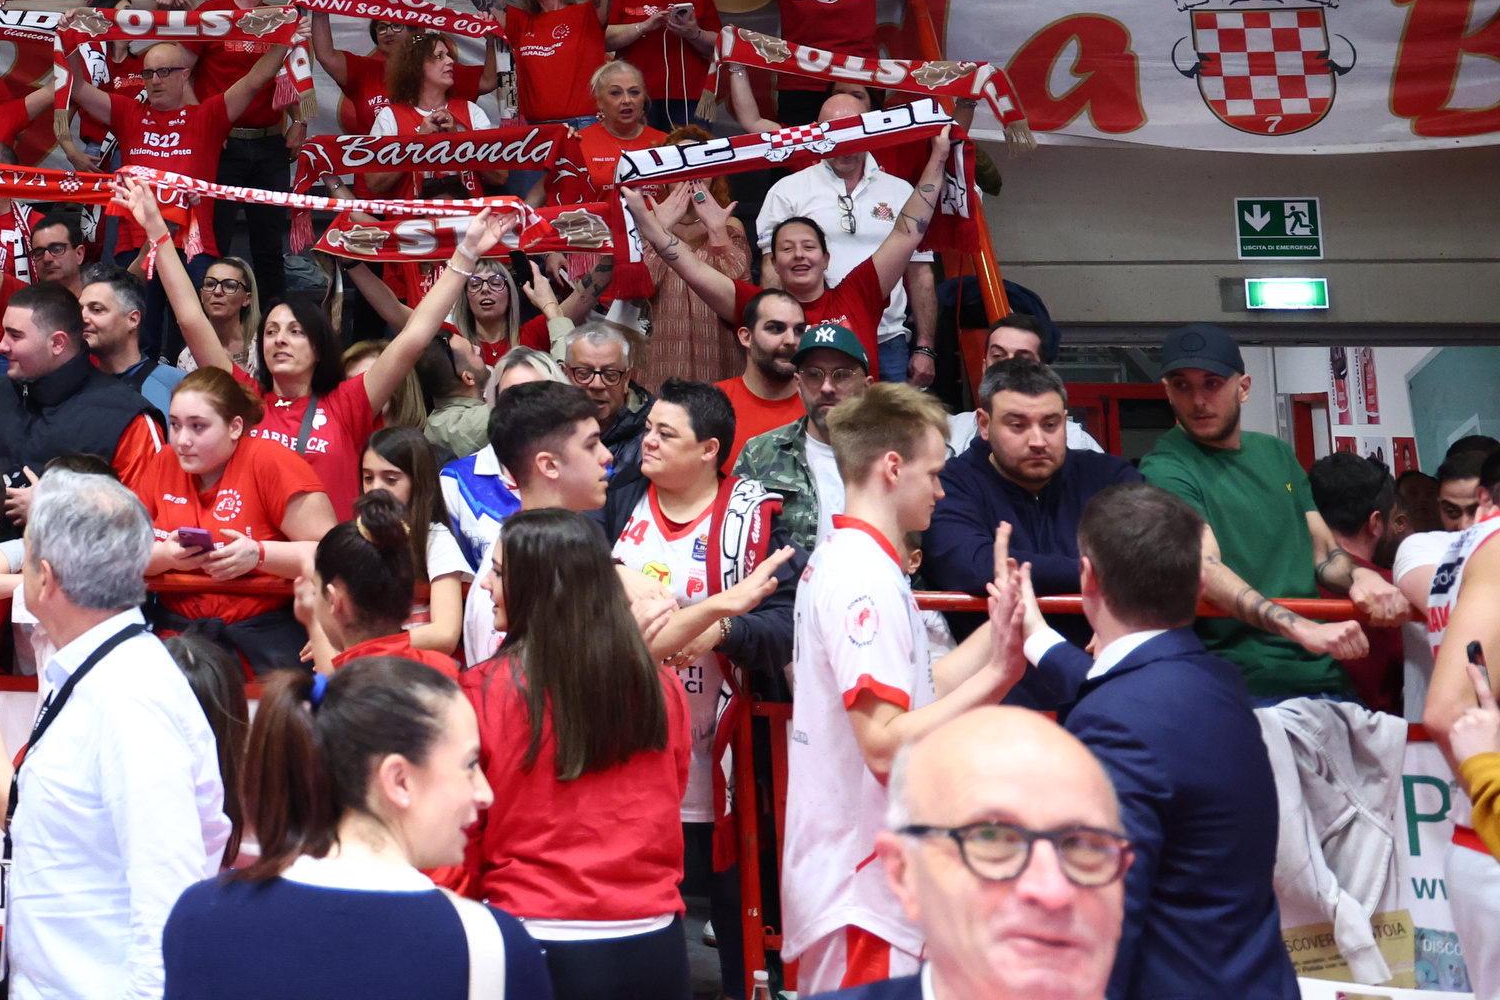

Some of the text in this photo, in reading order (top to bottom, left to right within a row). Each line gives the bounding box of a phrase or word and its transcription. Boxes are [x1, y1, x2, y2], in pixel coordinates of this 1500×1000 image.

[1264, 114, 1284, 134] 7
[143, 132, 180, 148] 1522
[337, 127, 554, 167] Baraonda
[161, 150, 170, 158] la
[1283, 933, 1336, 953] SCOVER
